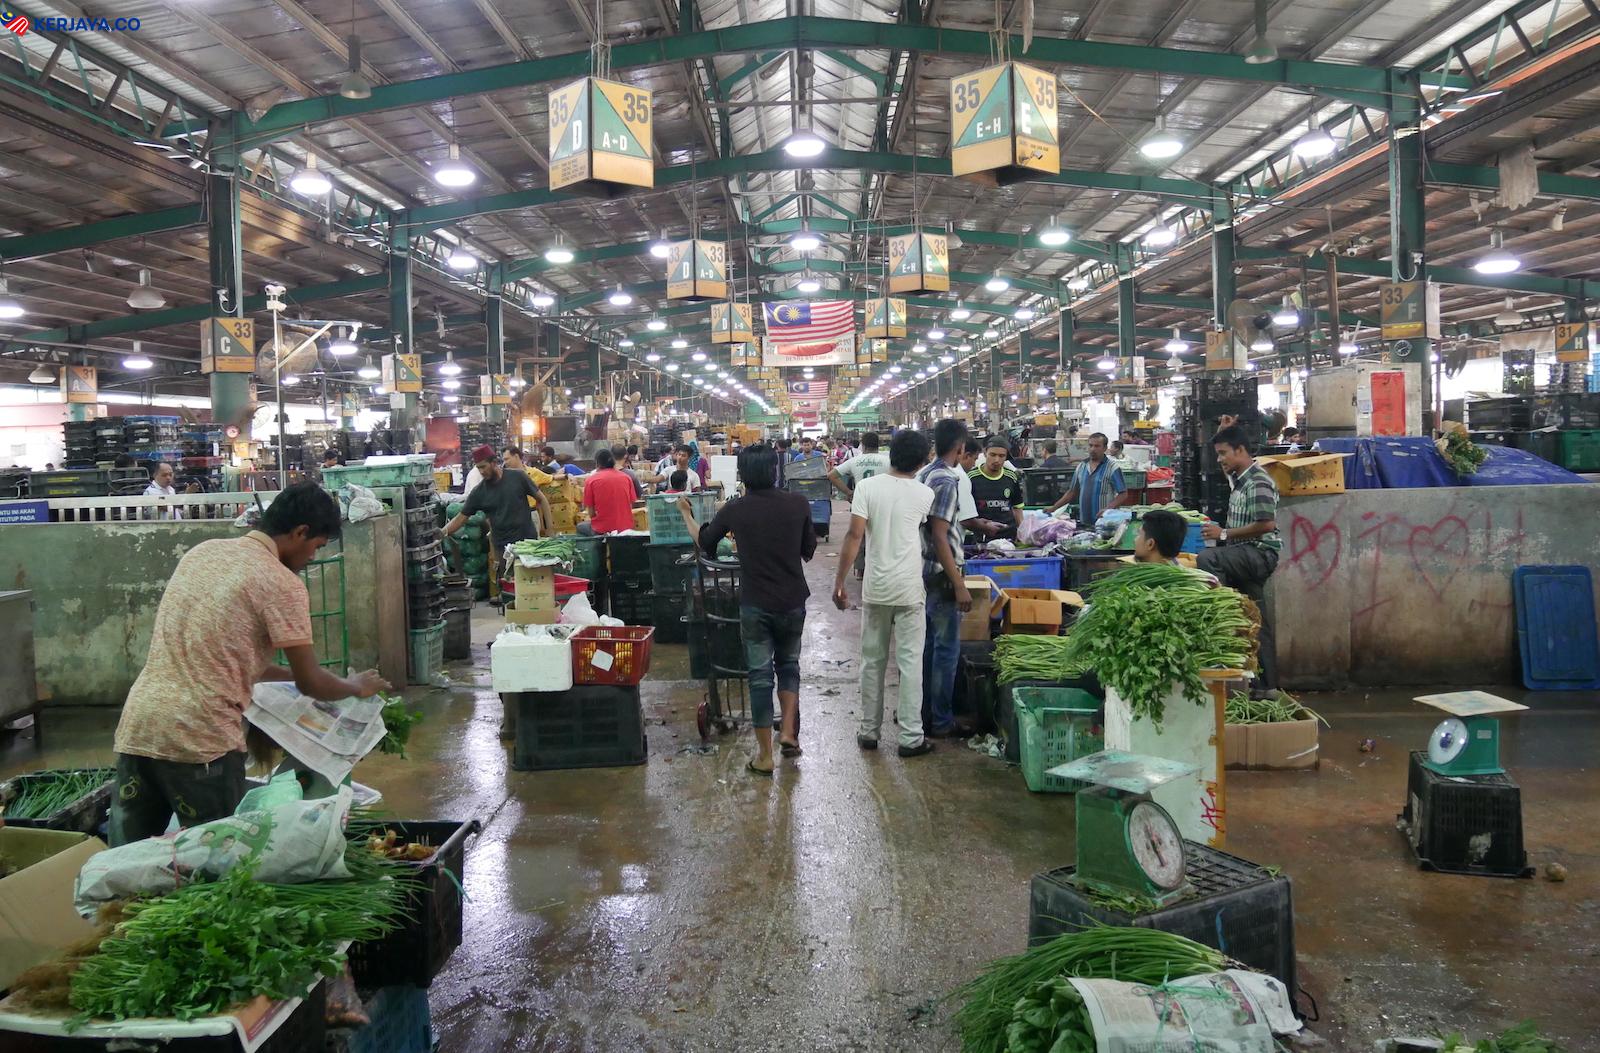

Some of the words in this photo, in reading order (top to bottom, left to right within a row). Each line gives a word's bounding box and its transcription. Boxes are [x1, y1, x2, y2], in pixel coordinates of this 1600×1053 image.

[954, 79, 980, 113] 35
[1035, 76, 1054, 109] 35
[551, 93, 568, 128] 35
[623, 92, 649, 123] 35
[1021, 102, 1031, 134] E
[572, 120, 582, 151] D
[710, 245, 723, 263] 33
[891, 240, 905, 257] 33
[934, 239, 946, 256] 33
[682, 261, 690, 279] D
[926, 254, 933, 272] E
[1384, 287, 1403, 305] 33
[741, 306, 751, 319] 31
[890, 311, 896, 325] E
[1408, 302, 1417, 320] F
[234, 321, 251, 339] 33
[1558, 325, 1572, 338] 31
[220, 336, 231, 354] C
[1574, 336, 1584, 349] H
[408, 356, 419, 368] 31
[83, 368, 94, 379] 31
[400, 367, 407, 380] C
[72, 379, 80, 391] A
